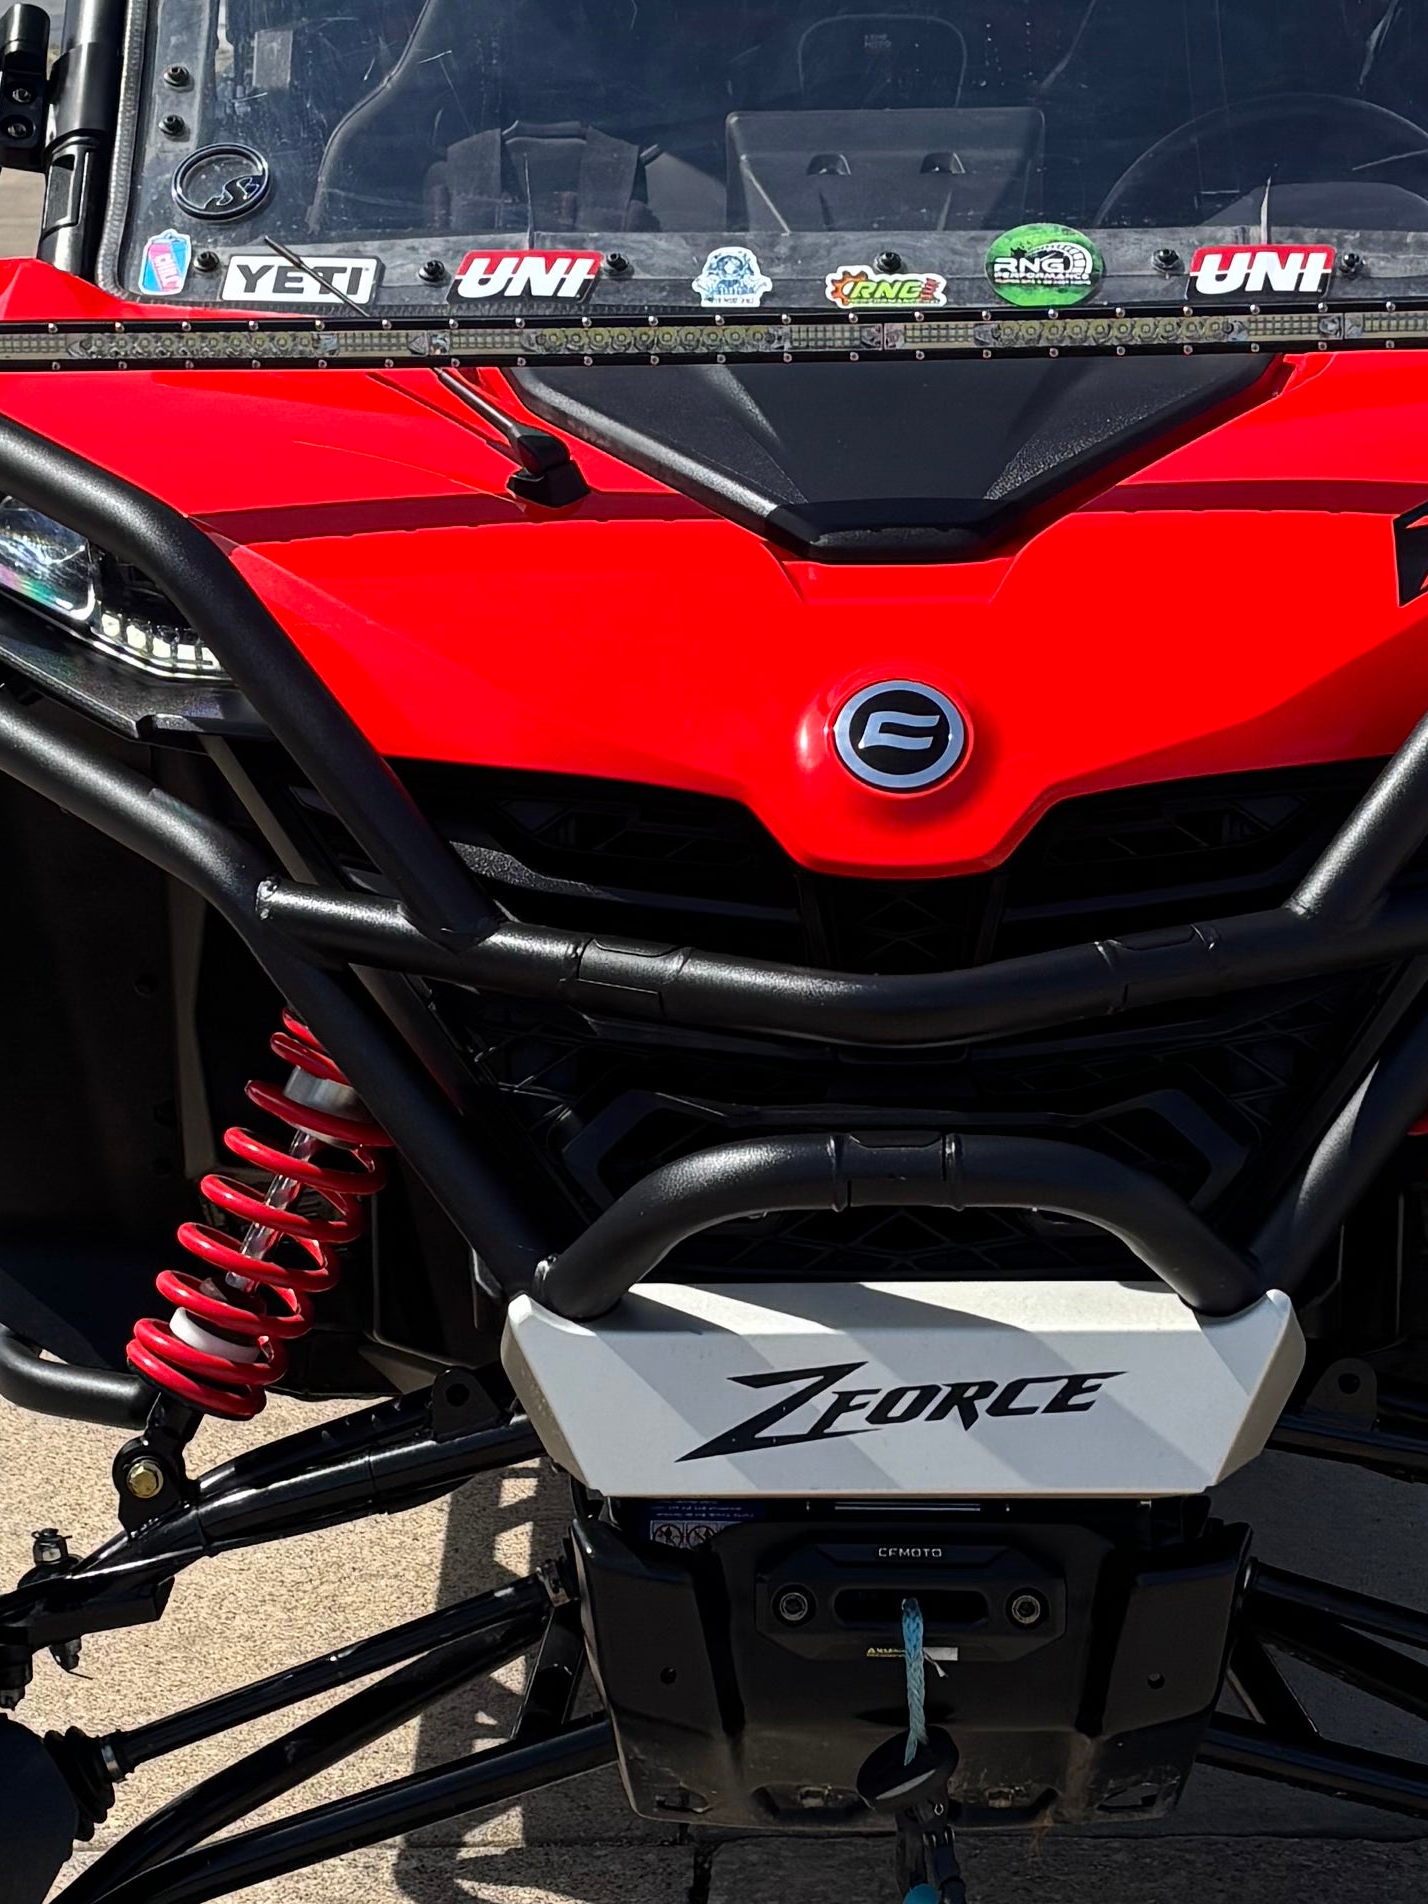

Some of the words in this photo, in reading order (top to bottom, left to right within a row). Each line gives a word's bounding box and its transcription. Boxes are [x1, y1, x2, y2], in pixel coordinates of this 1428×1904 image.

[236, 264, 364, 296] YETI
[457, 256, 596, 299] UNI
[1195, 251, 1328, 295] UNI
[673, 1360, 1129, 1463] ZFORCE
[878, 1547, 943, 1558] CFMOTO
